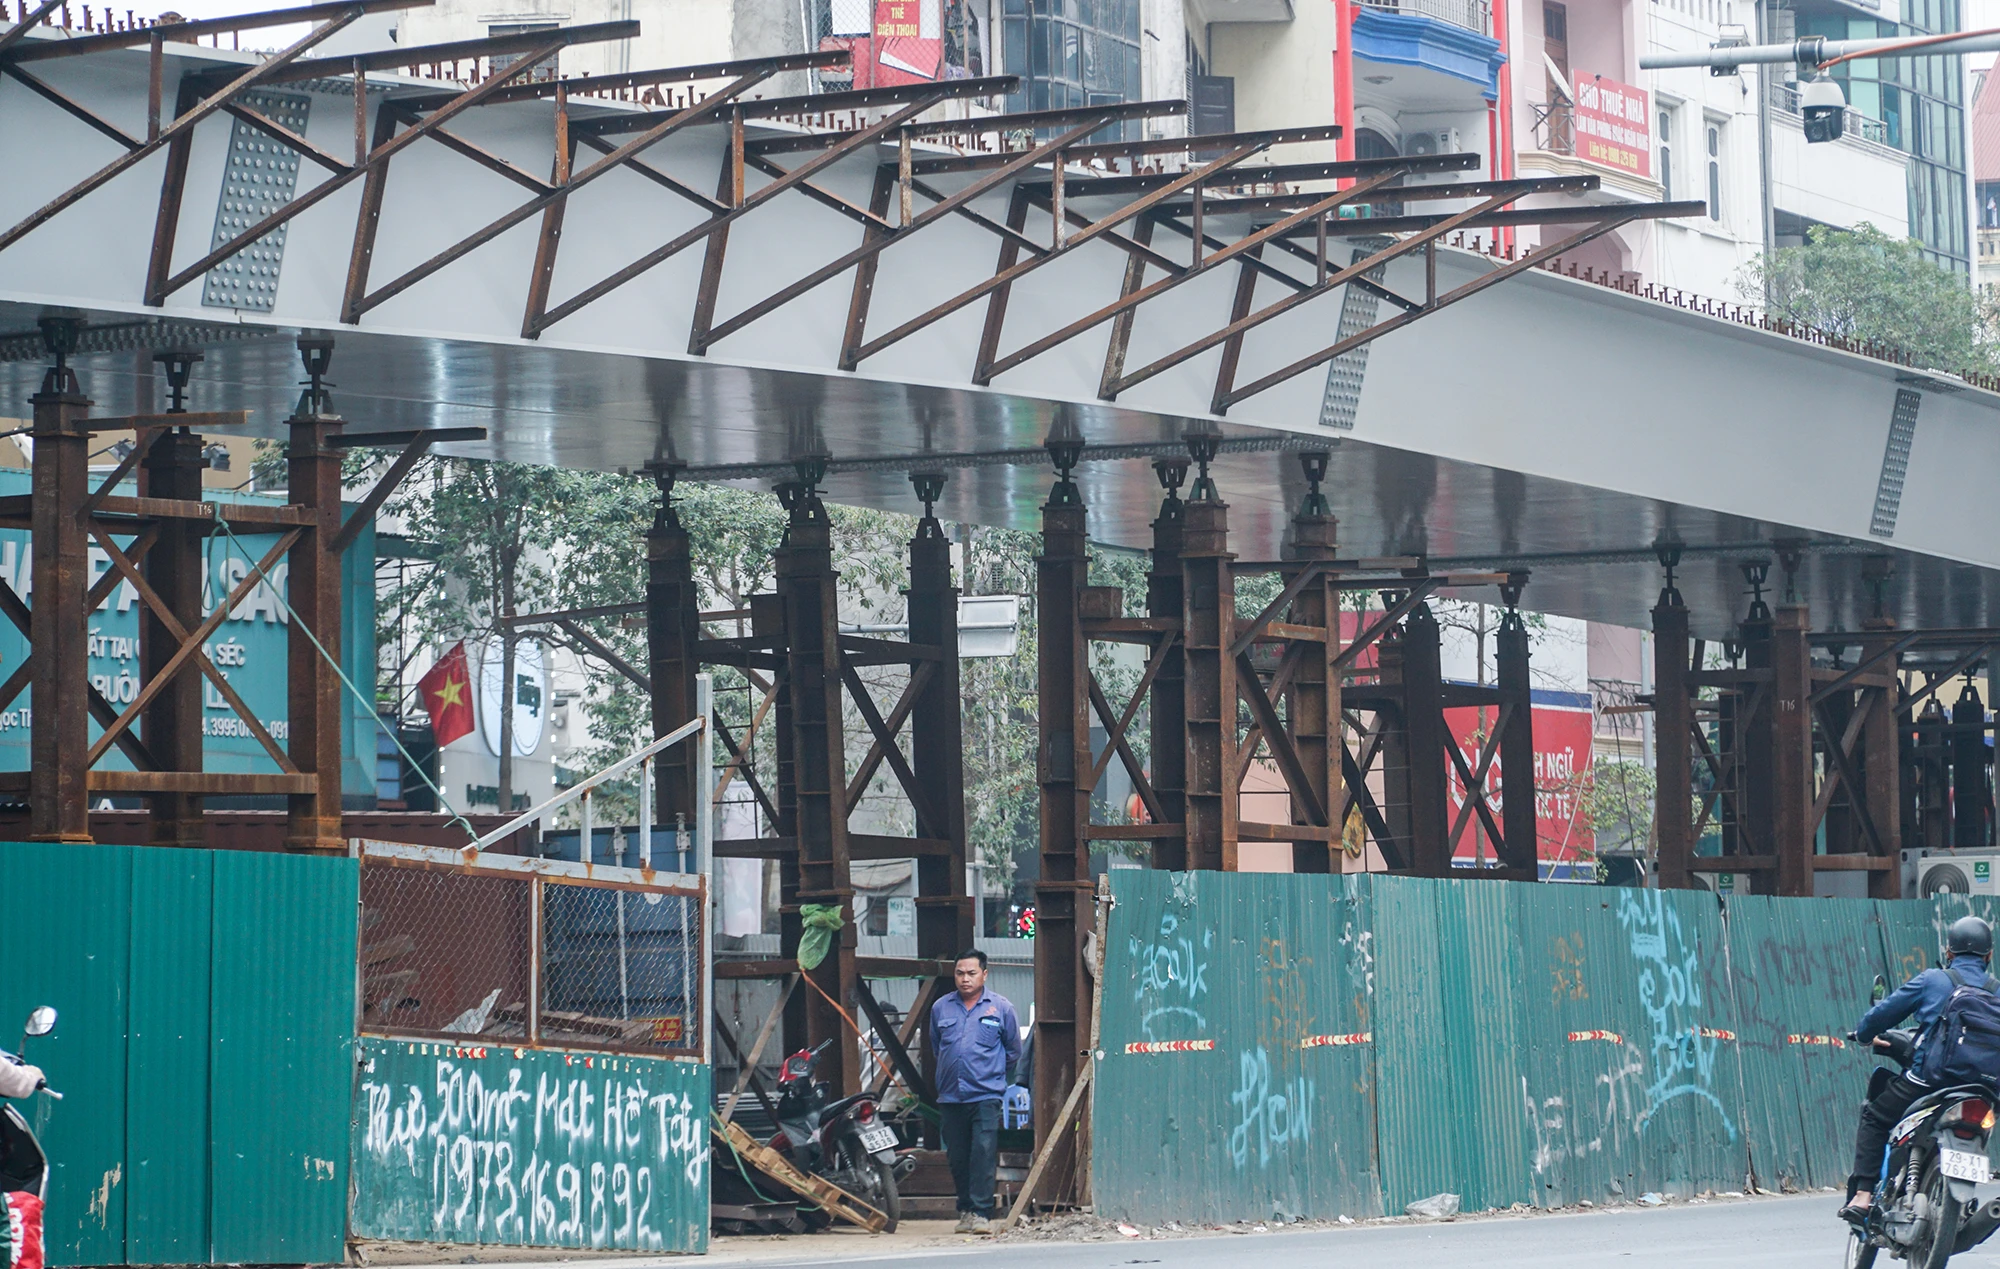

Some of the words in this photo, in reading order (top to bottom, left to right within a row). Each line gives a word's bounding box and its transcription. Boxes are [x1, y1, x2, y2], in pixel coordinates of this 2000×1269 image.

[890, 4, 905, 19] THẺ
[896, 24, 918, 39] THOẠI
[1579, 82, 1599, 110] CHO
[1600, 89, 1624, 118] THUÊ
[1625, 95, 1645, 125] NHÀ
[216, 636, 246, 666] SÉC
[1949, 1151, 1981, 1167] 29-X1
[1945, 1162, 1985, 1181] 762.81
